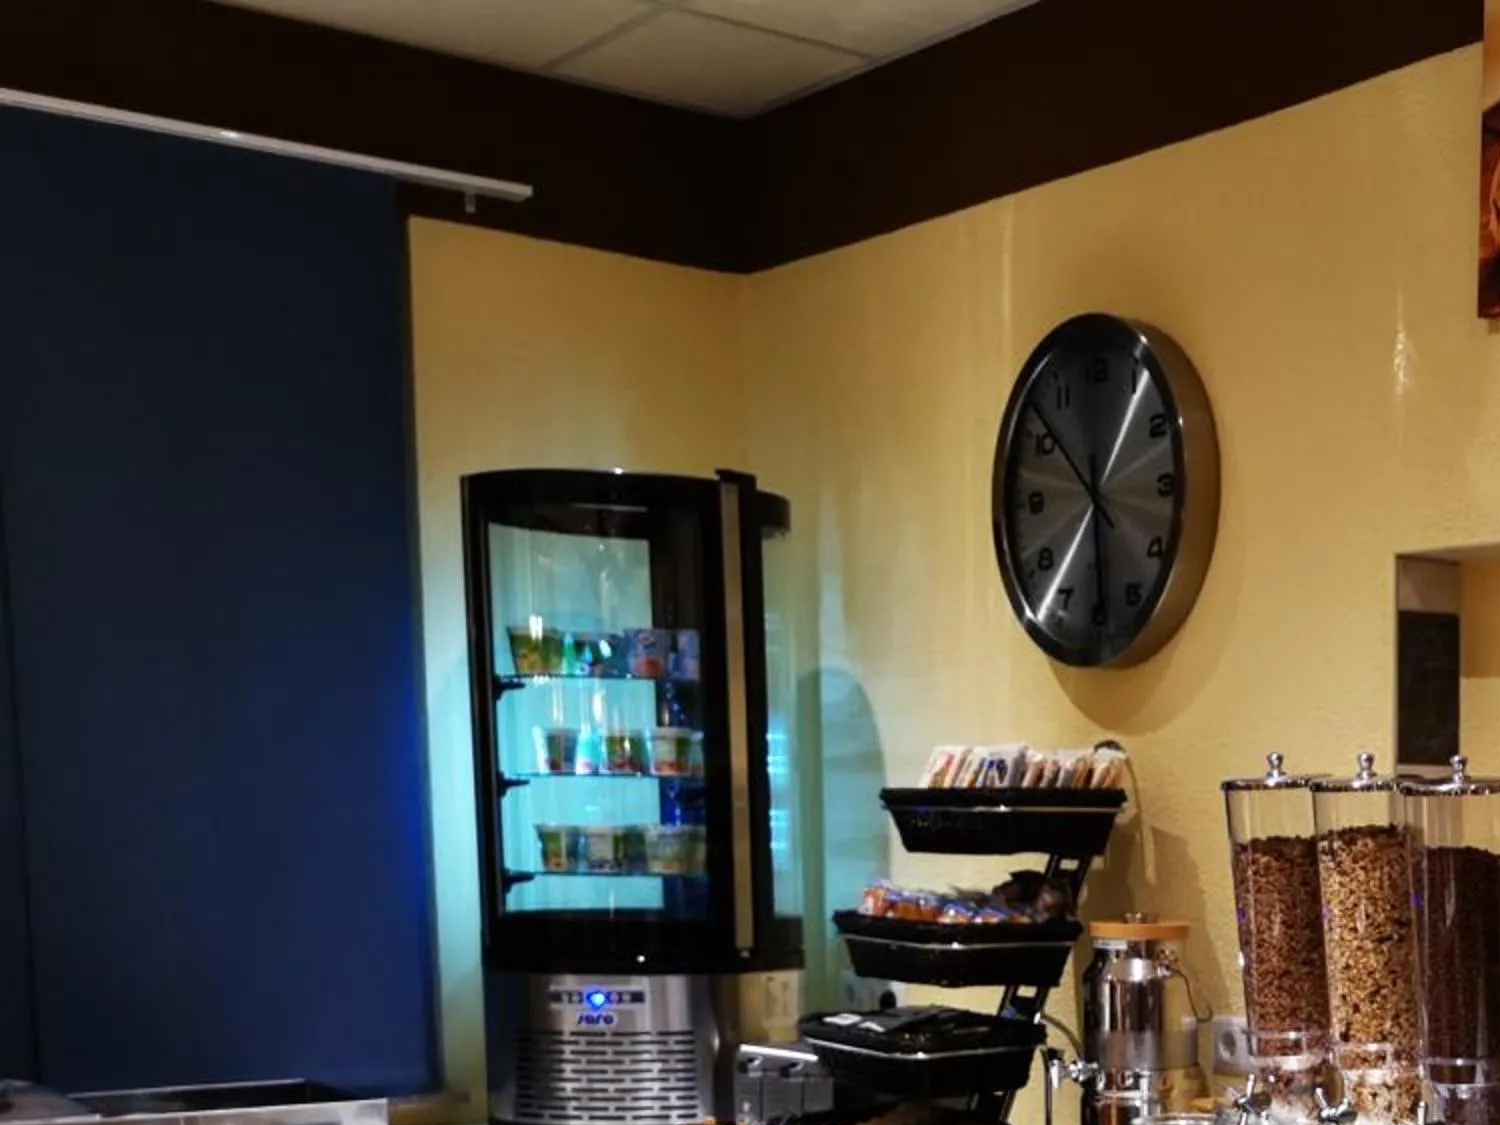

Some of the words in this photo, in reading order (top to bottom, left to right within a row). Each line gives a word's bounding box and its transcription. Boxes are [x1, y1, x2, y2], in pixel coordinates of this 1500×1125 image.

[1056, 385, 1071, 410] 11
[1149, 413, 1167, 438] 2
[1034, 432, 1058, 456] 10
[1156, 473, 1175, 498] 3
[1028, 492, 1045, 514] 9
[1037, 548, 1054, 571] 8
[1146, 536, 1164, 559] 4
[1058, 587, 1075, 611] 7
[1124, 583, 1143, 607] 5
